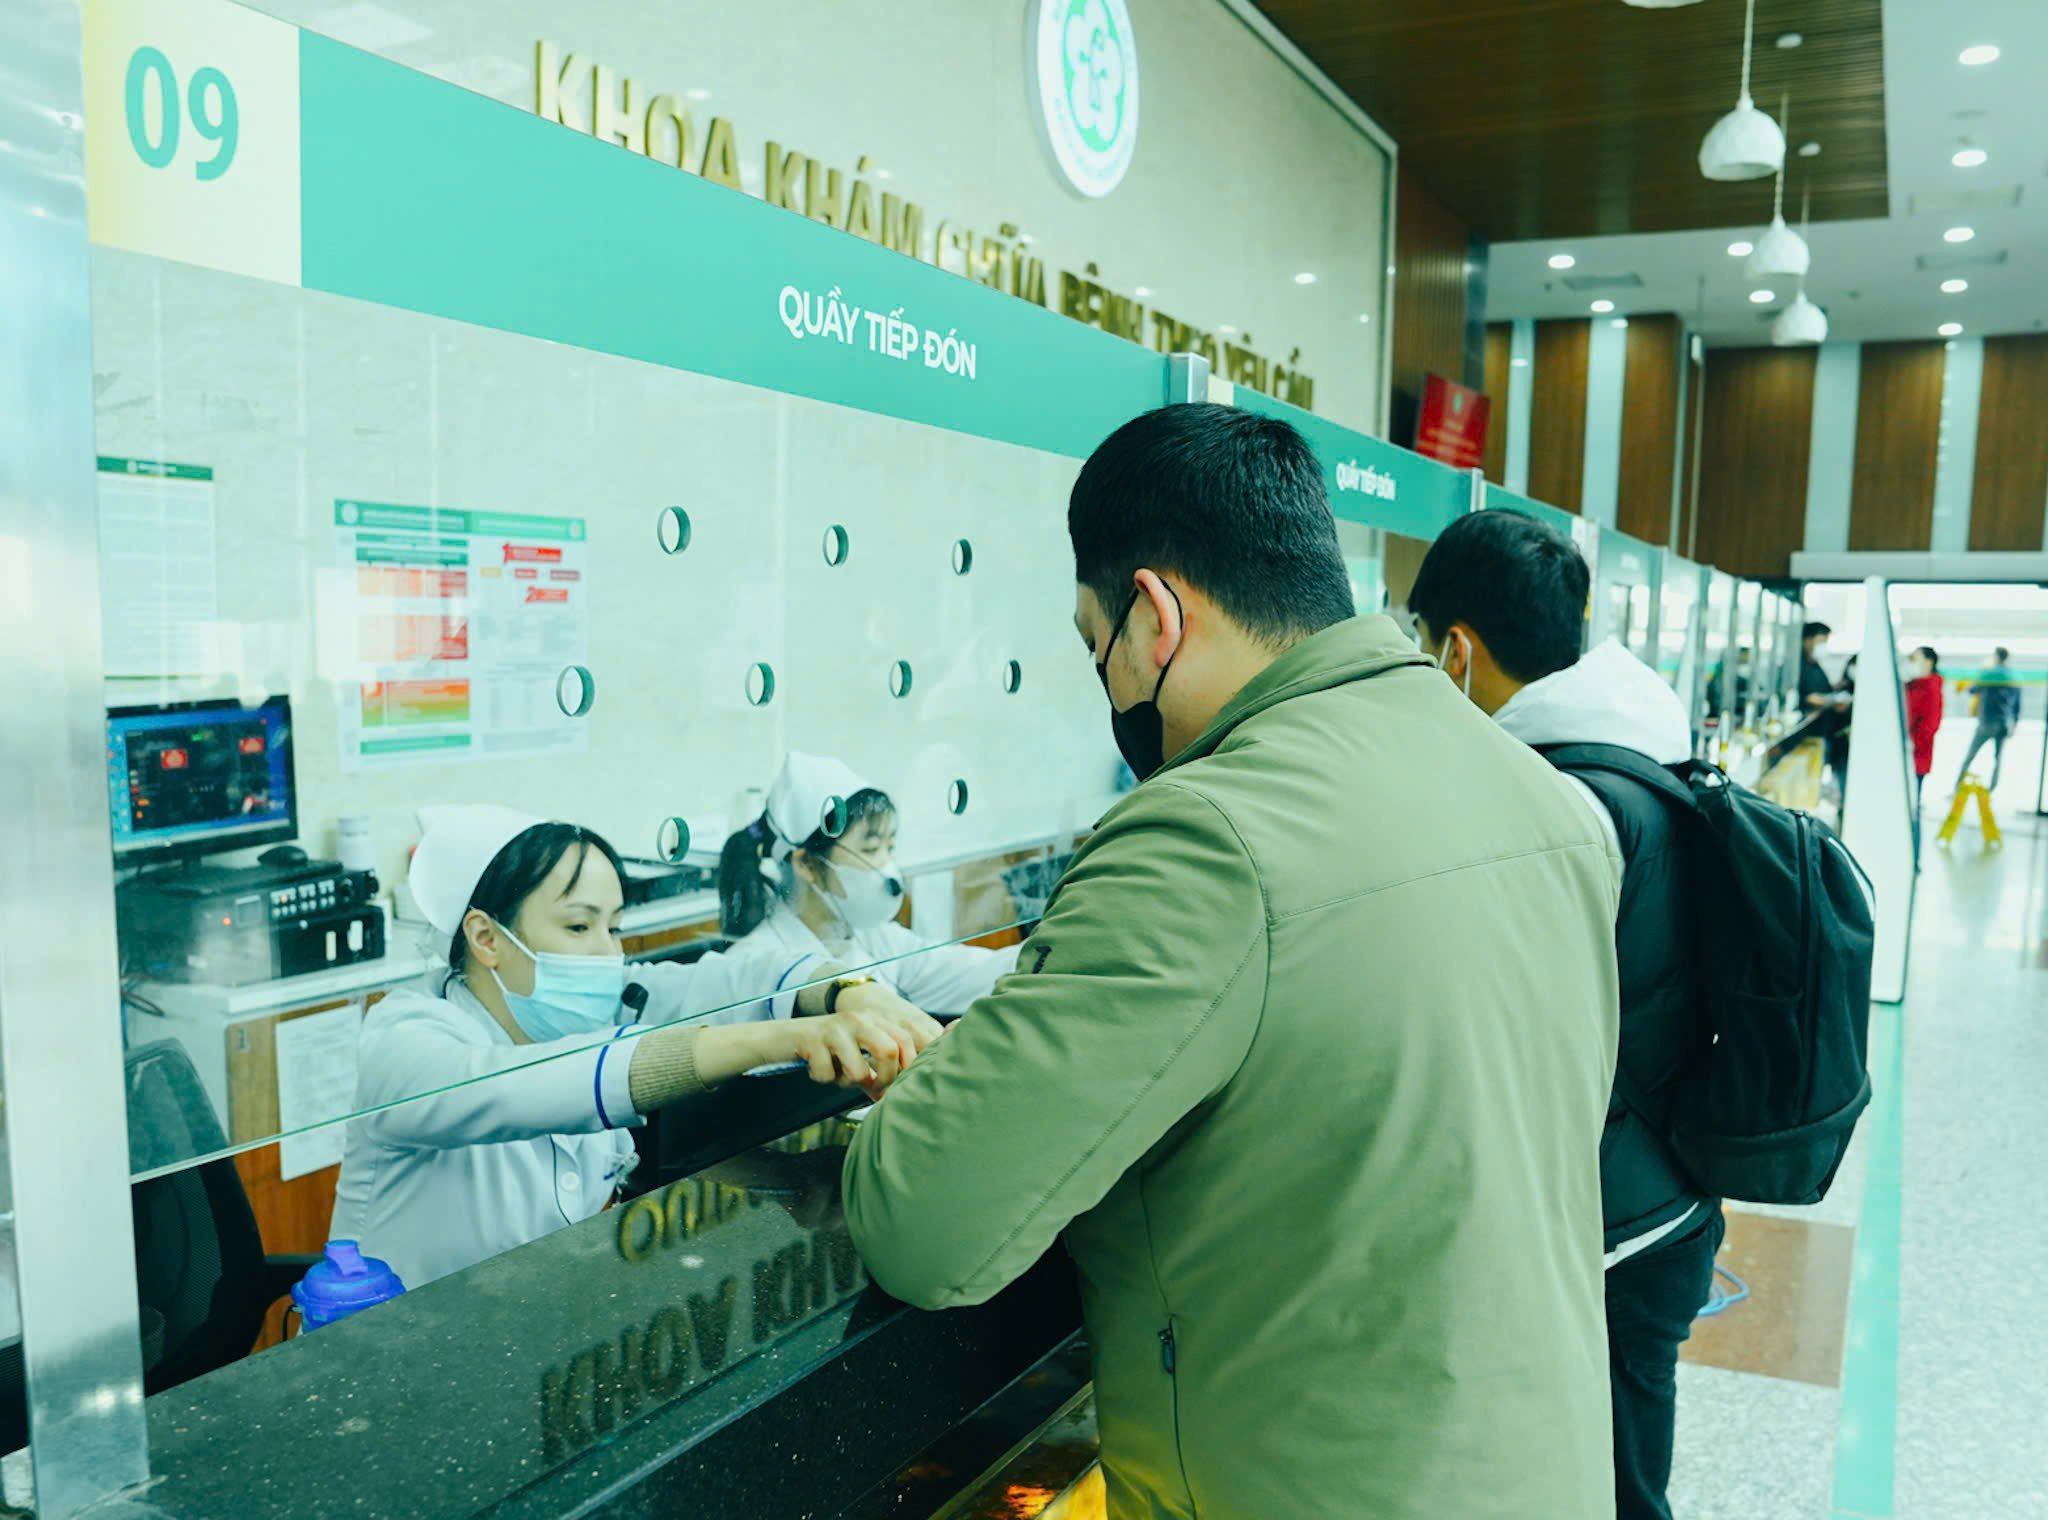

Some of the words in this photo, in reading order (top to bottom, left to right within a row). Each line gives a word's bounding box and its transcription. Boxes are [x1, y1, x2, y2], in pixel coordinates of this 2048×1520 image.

[125, 46, 239, 181] 09
[535, 38, 744, 192] KHOA
[765, 140, 924, 260] KHÁM
[778, 285, 860, 344] QUẦY
[863, 307, 919, 361] TIẾP
[923, 327, 977, 380] ĐÓN
